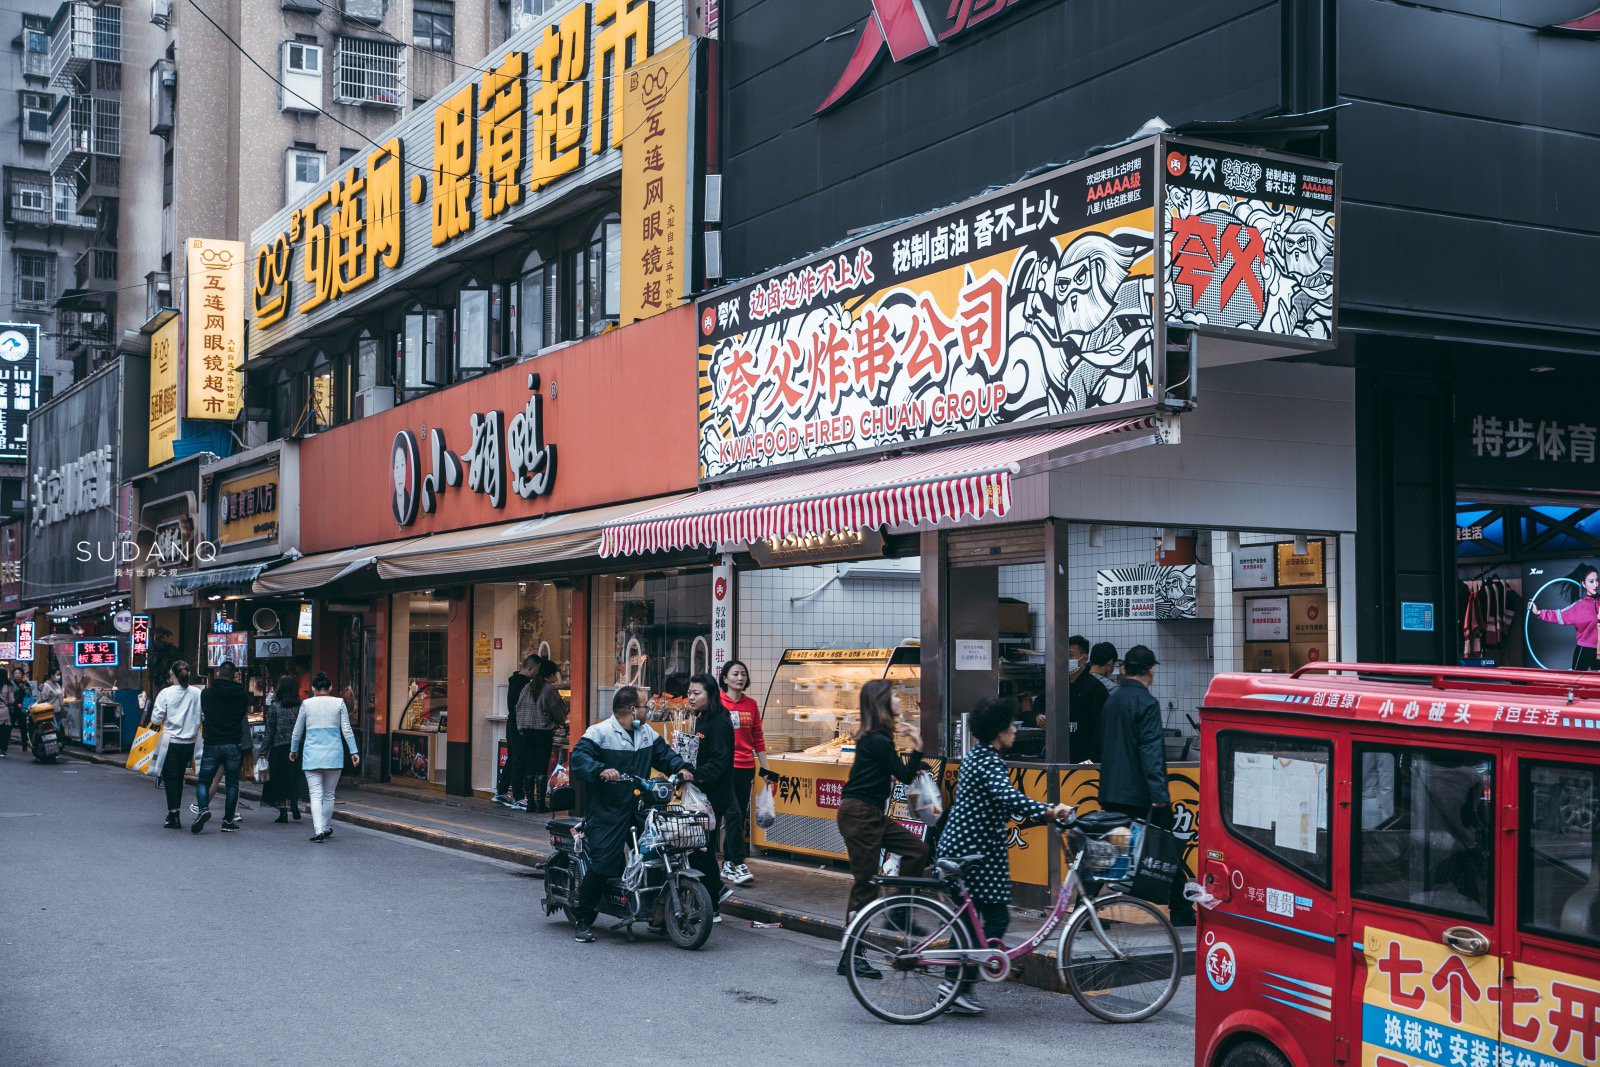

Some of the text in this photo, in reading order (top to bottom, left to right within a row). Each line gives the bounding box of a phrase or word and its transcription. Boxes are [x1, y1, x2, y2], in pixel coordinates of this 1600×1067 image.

[1086, 157, 1142, 186] 欢迎来到上古时期
[1221, 157, 1263, 182] 边卤边炸
[1224, 173, 1257, 193] 不上火
[1265, 167, 1297, 185] 秘制卤油
[1086, 171, 1141, 203] AAAAA级
[1086, 188, 1141, 217] 八星八钻名胜景区
[1265, 181, 1296, 196] 香不上火
[641, 111, 666, 309] 互连网眼镜超
[892, 188, 1060, 275] 秘制卤油 香不上火
[749, 247, 875, 319] 边卤边炸不上火
[203, 275, 226, 413] 互连网眼镜超市
[720, 277, 1003, 425] 夸父炸串公司
[719, 384, 1007, 464] KWAFOOD FIRED CHUAN GROUP
[1472, 415, 1598, 463] 特步体育
[84, 643, 109, 653] 张记
[1377, 698, 1472, 725] 小心碰头
[1247, 886, 1265, 902] 享受
[1268, 890, 1293, 916] 尊贵
[1384, 1013, 1558, 1067] 换锁芯 安装指
